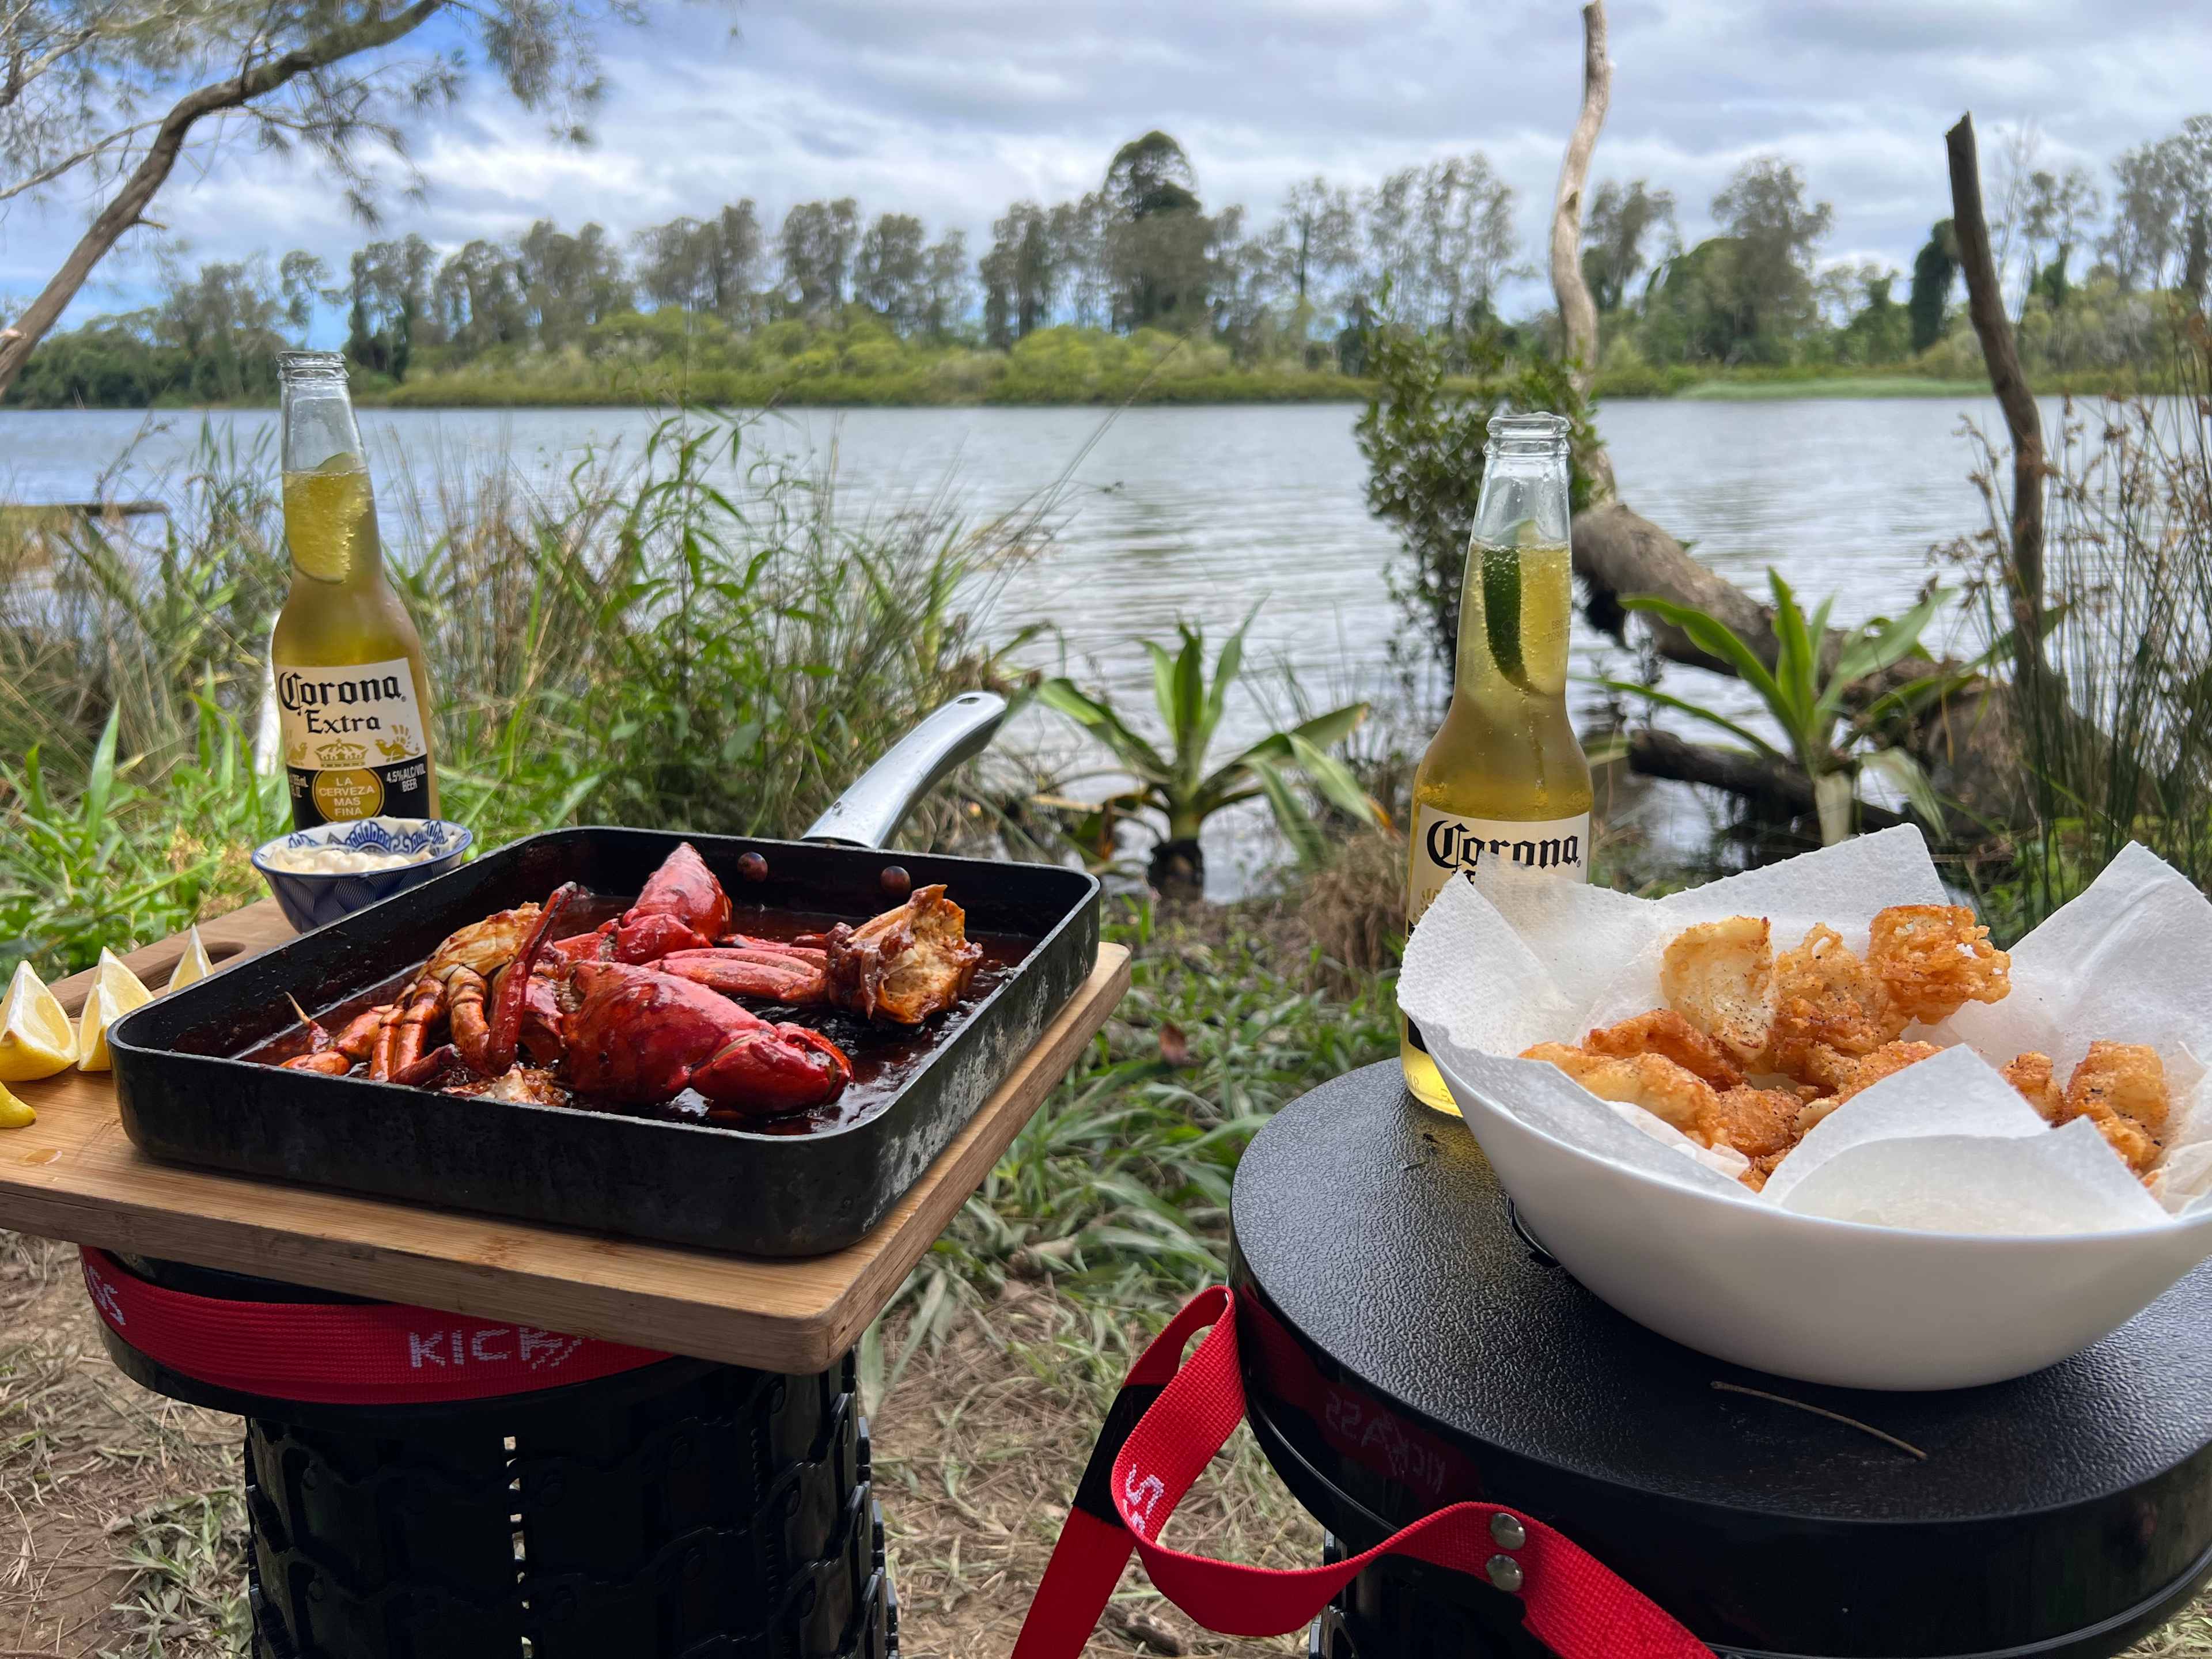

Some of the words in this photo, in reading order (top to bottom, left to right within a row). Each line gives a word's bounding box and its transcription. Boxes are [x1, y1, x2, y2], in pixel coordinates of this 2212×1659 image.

[279, 672, 402, 715] Corona
[305, 709, 381, 734] Extra
[336, 778, 353, 786] LA
[402, 778, 418, 793] BEER
[319, 785, 375, 797] CERVEZA
[334, 798, 361, 806] MAS
[335, 808, 363, 816] FINA
